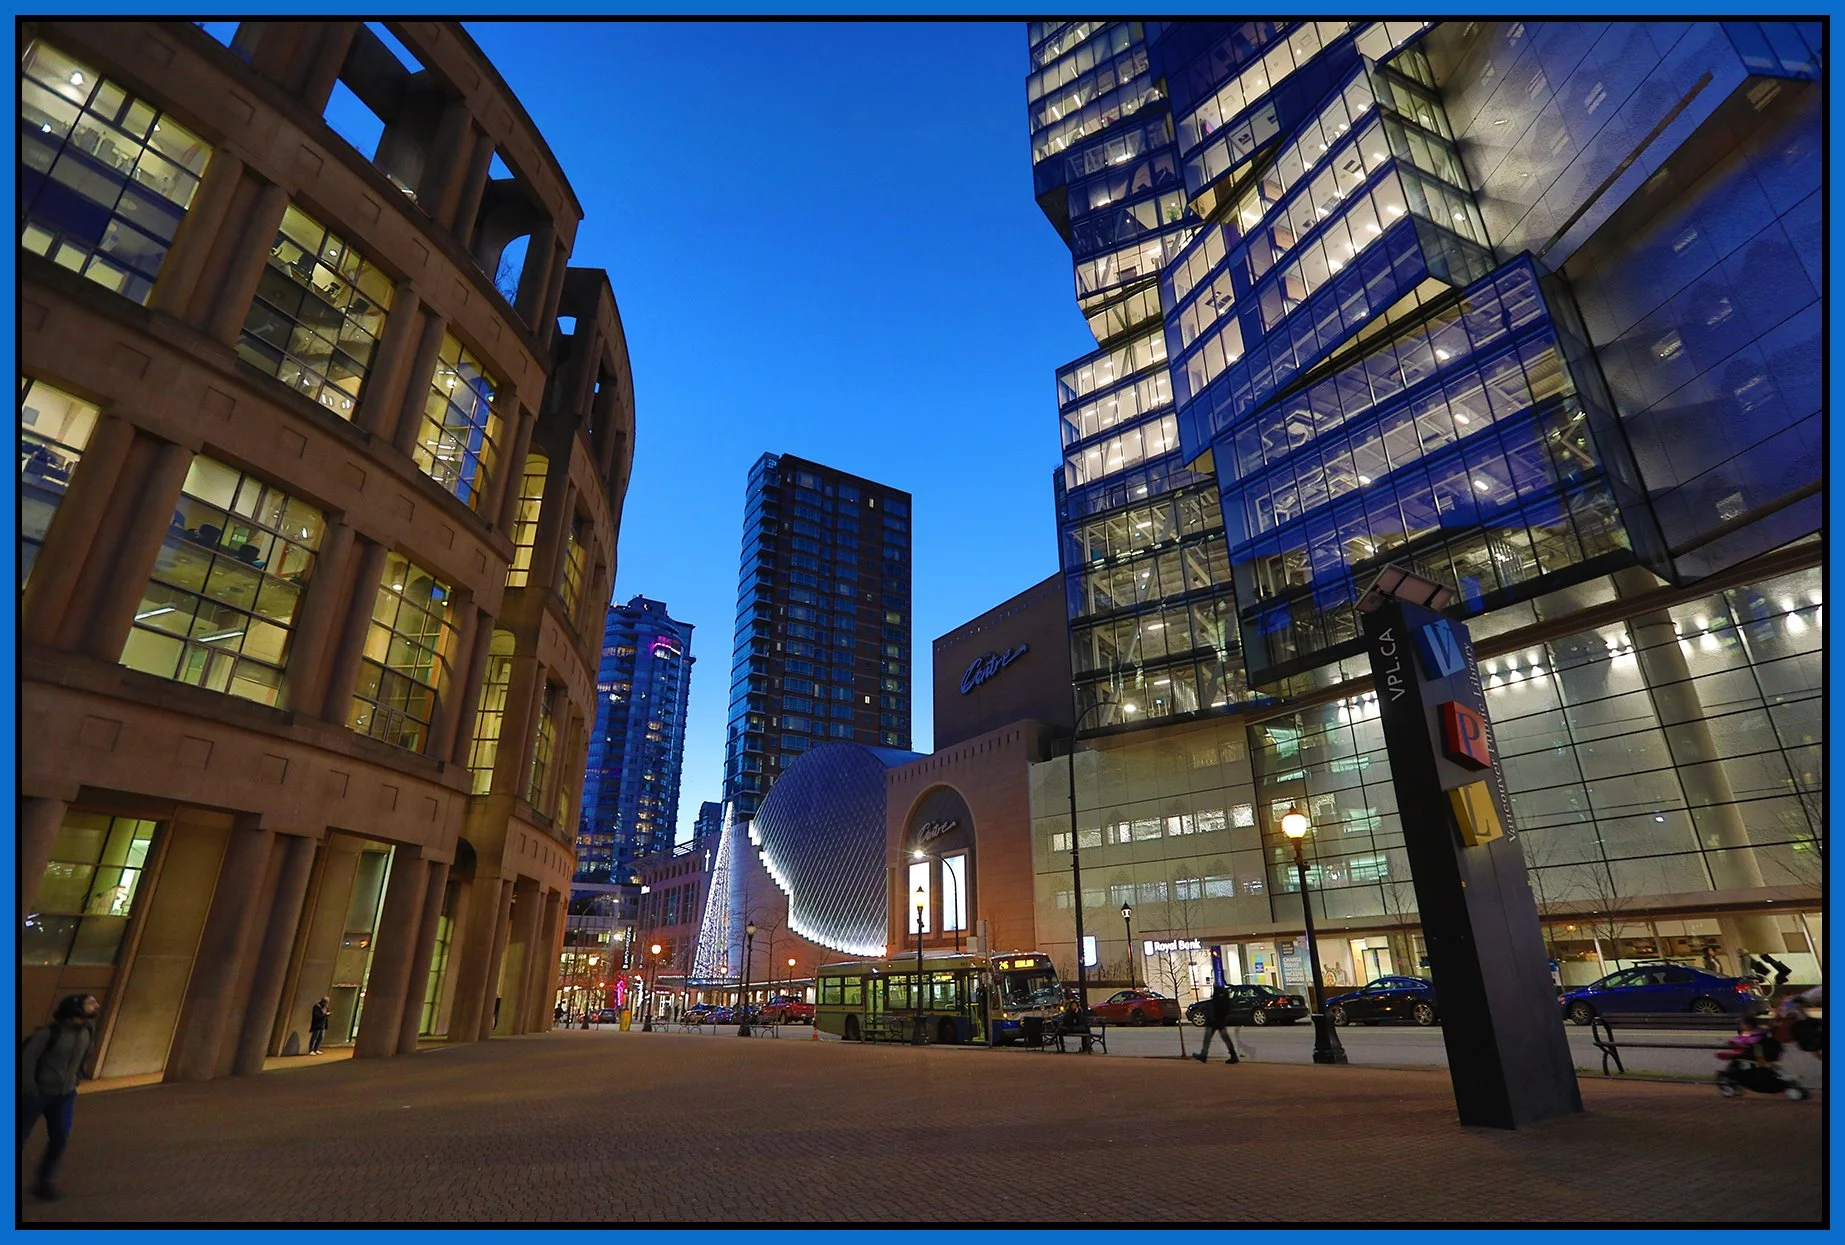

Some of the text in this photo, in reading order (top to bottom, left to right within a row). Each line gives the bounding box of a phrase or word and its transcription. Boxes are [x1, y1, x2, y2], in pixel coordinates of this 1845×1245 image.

[960, 643, 1029, 695] Centre
[1380, 627, 1405, 701] VPL.CA
[1431, 622, 1451, 670] V
[1463, 642, 1482, 698] Library
[1456, 711, 1480, 756] P
[1462, 785, 1492, 837] L
[1492, 759, 1517, 843] Vancouver
[917, 820, 957, 845] Centre
[1153, 938, 1201, 954] Royal Bank
